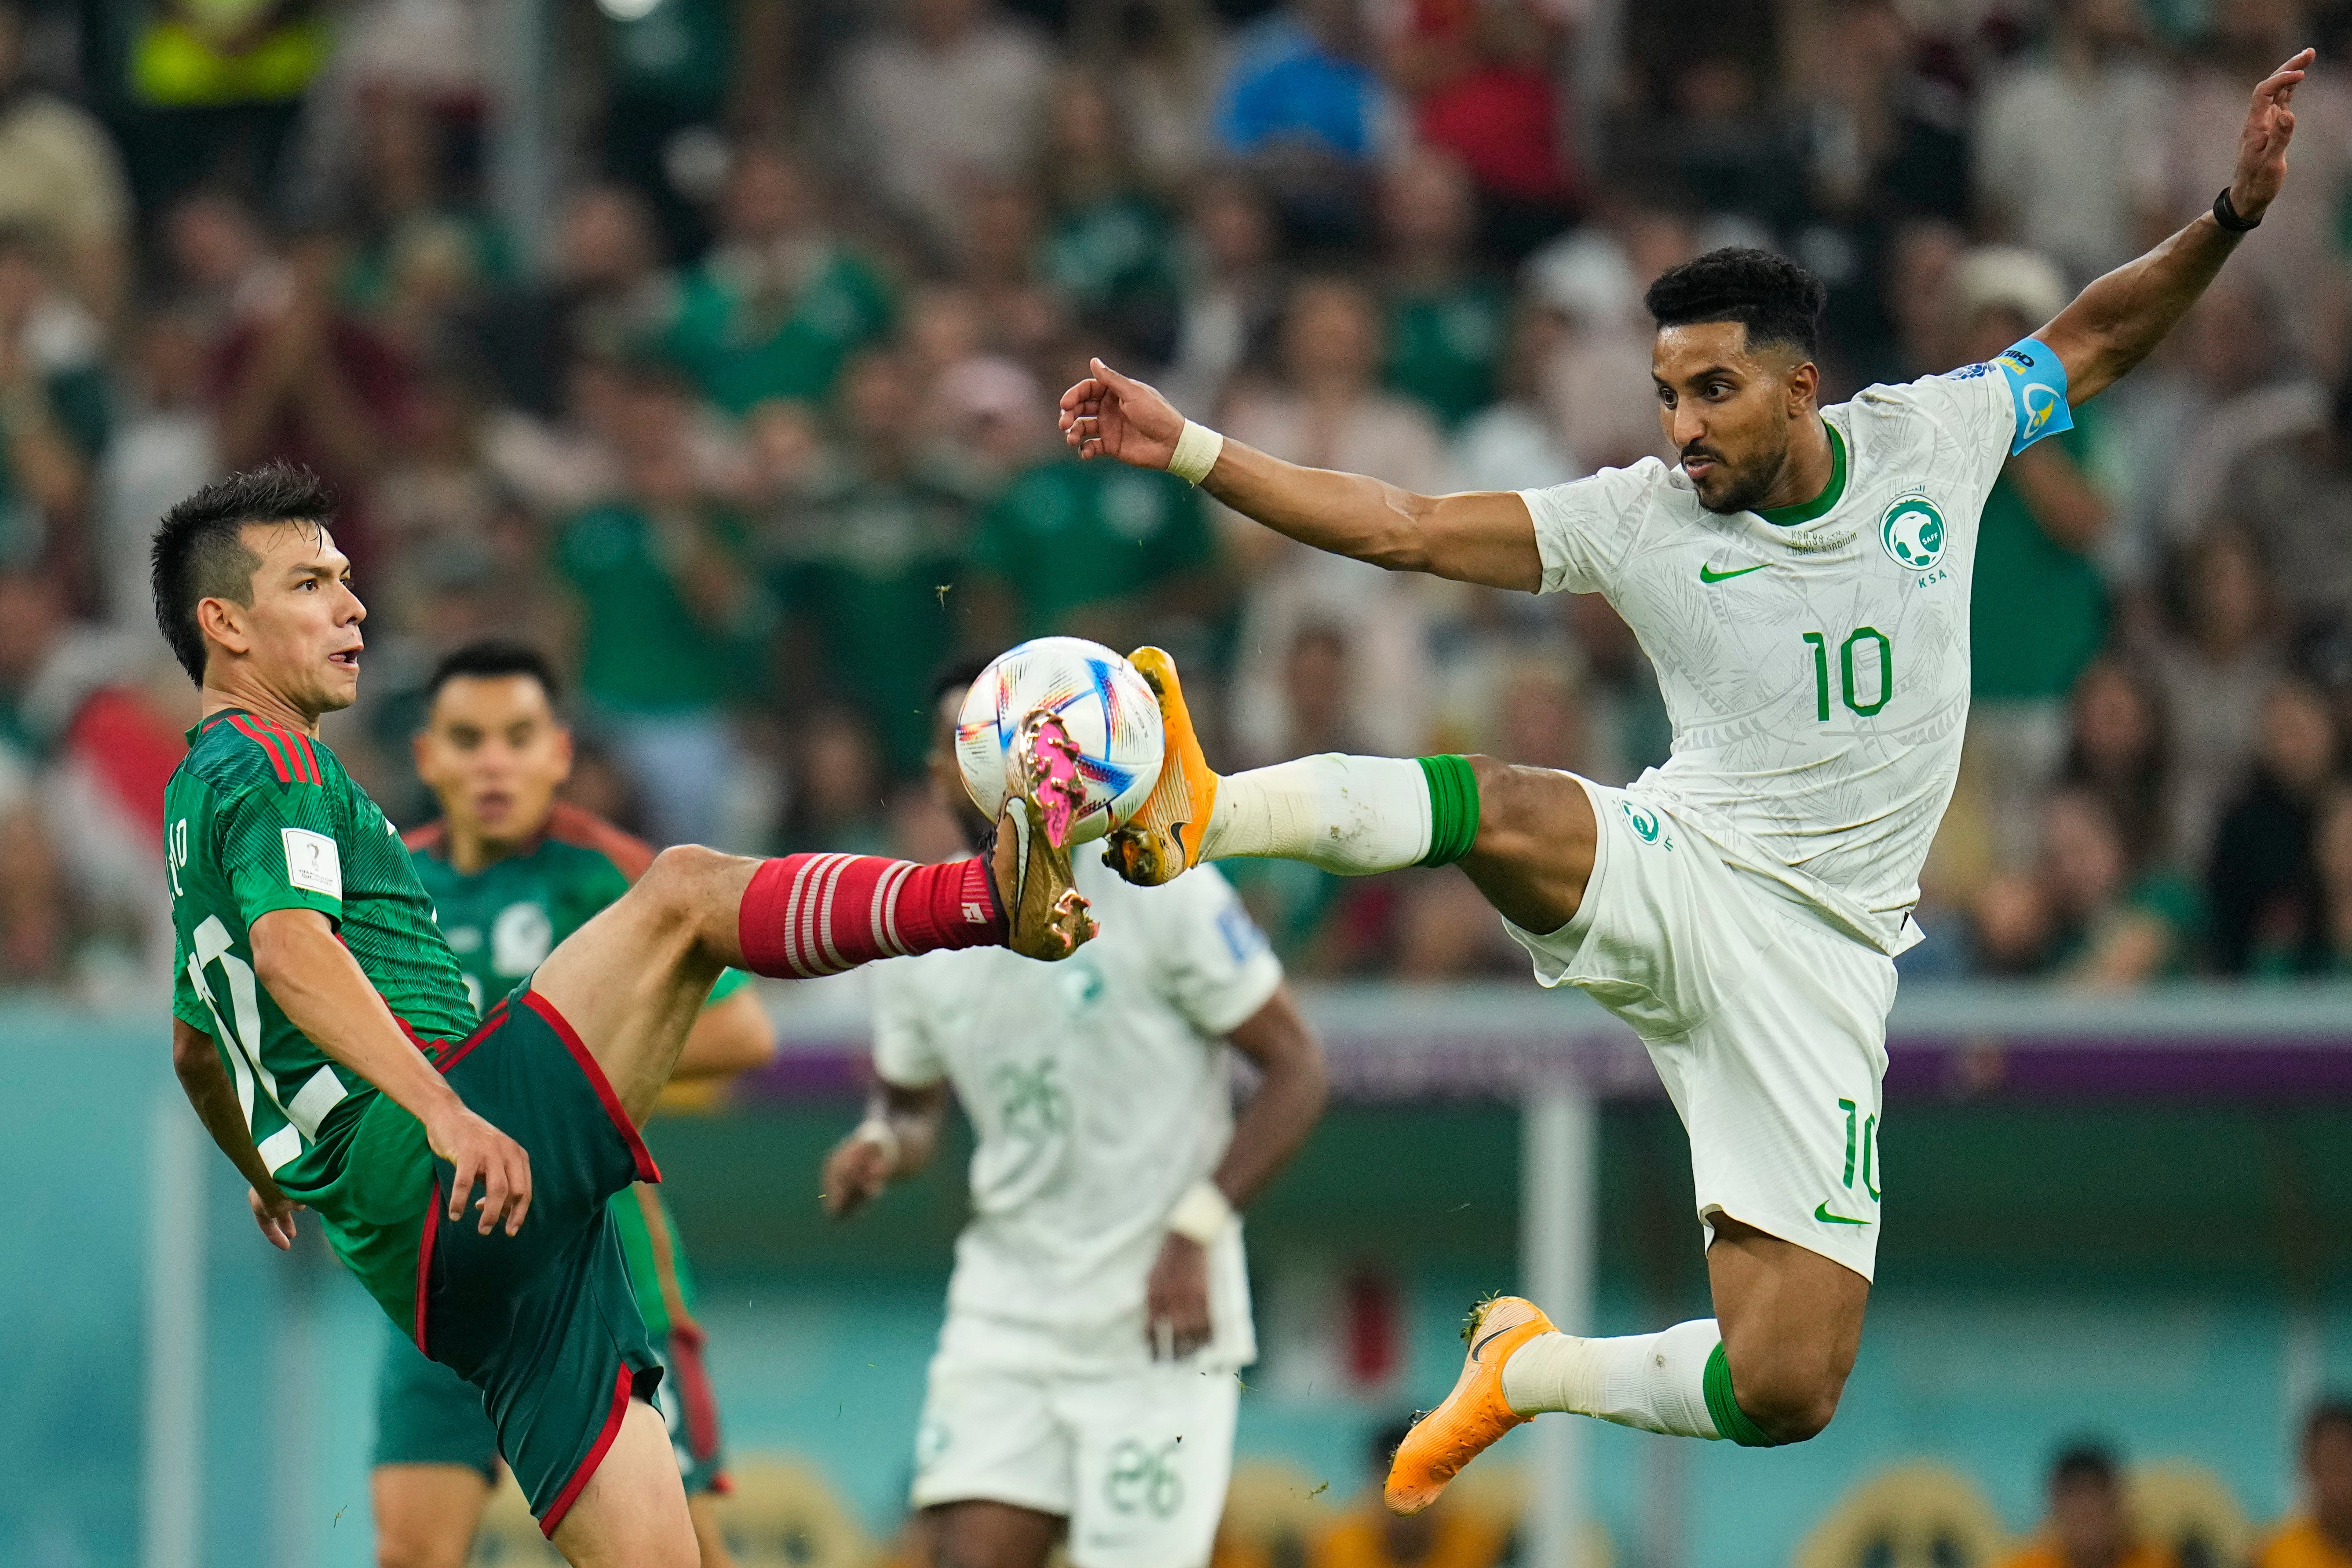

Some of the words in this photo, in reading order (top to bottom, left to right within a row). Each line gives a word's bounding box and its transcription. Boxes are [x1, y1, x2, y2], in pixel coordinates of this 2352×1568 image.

[1922, 532, 1938, 545] SAFF
[1918, 570, 1947, 588] KSA
[1803, 626, 1892, 721] 10
[1103, 1436, 1186, 1519] 26
